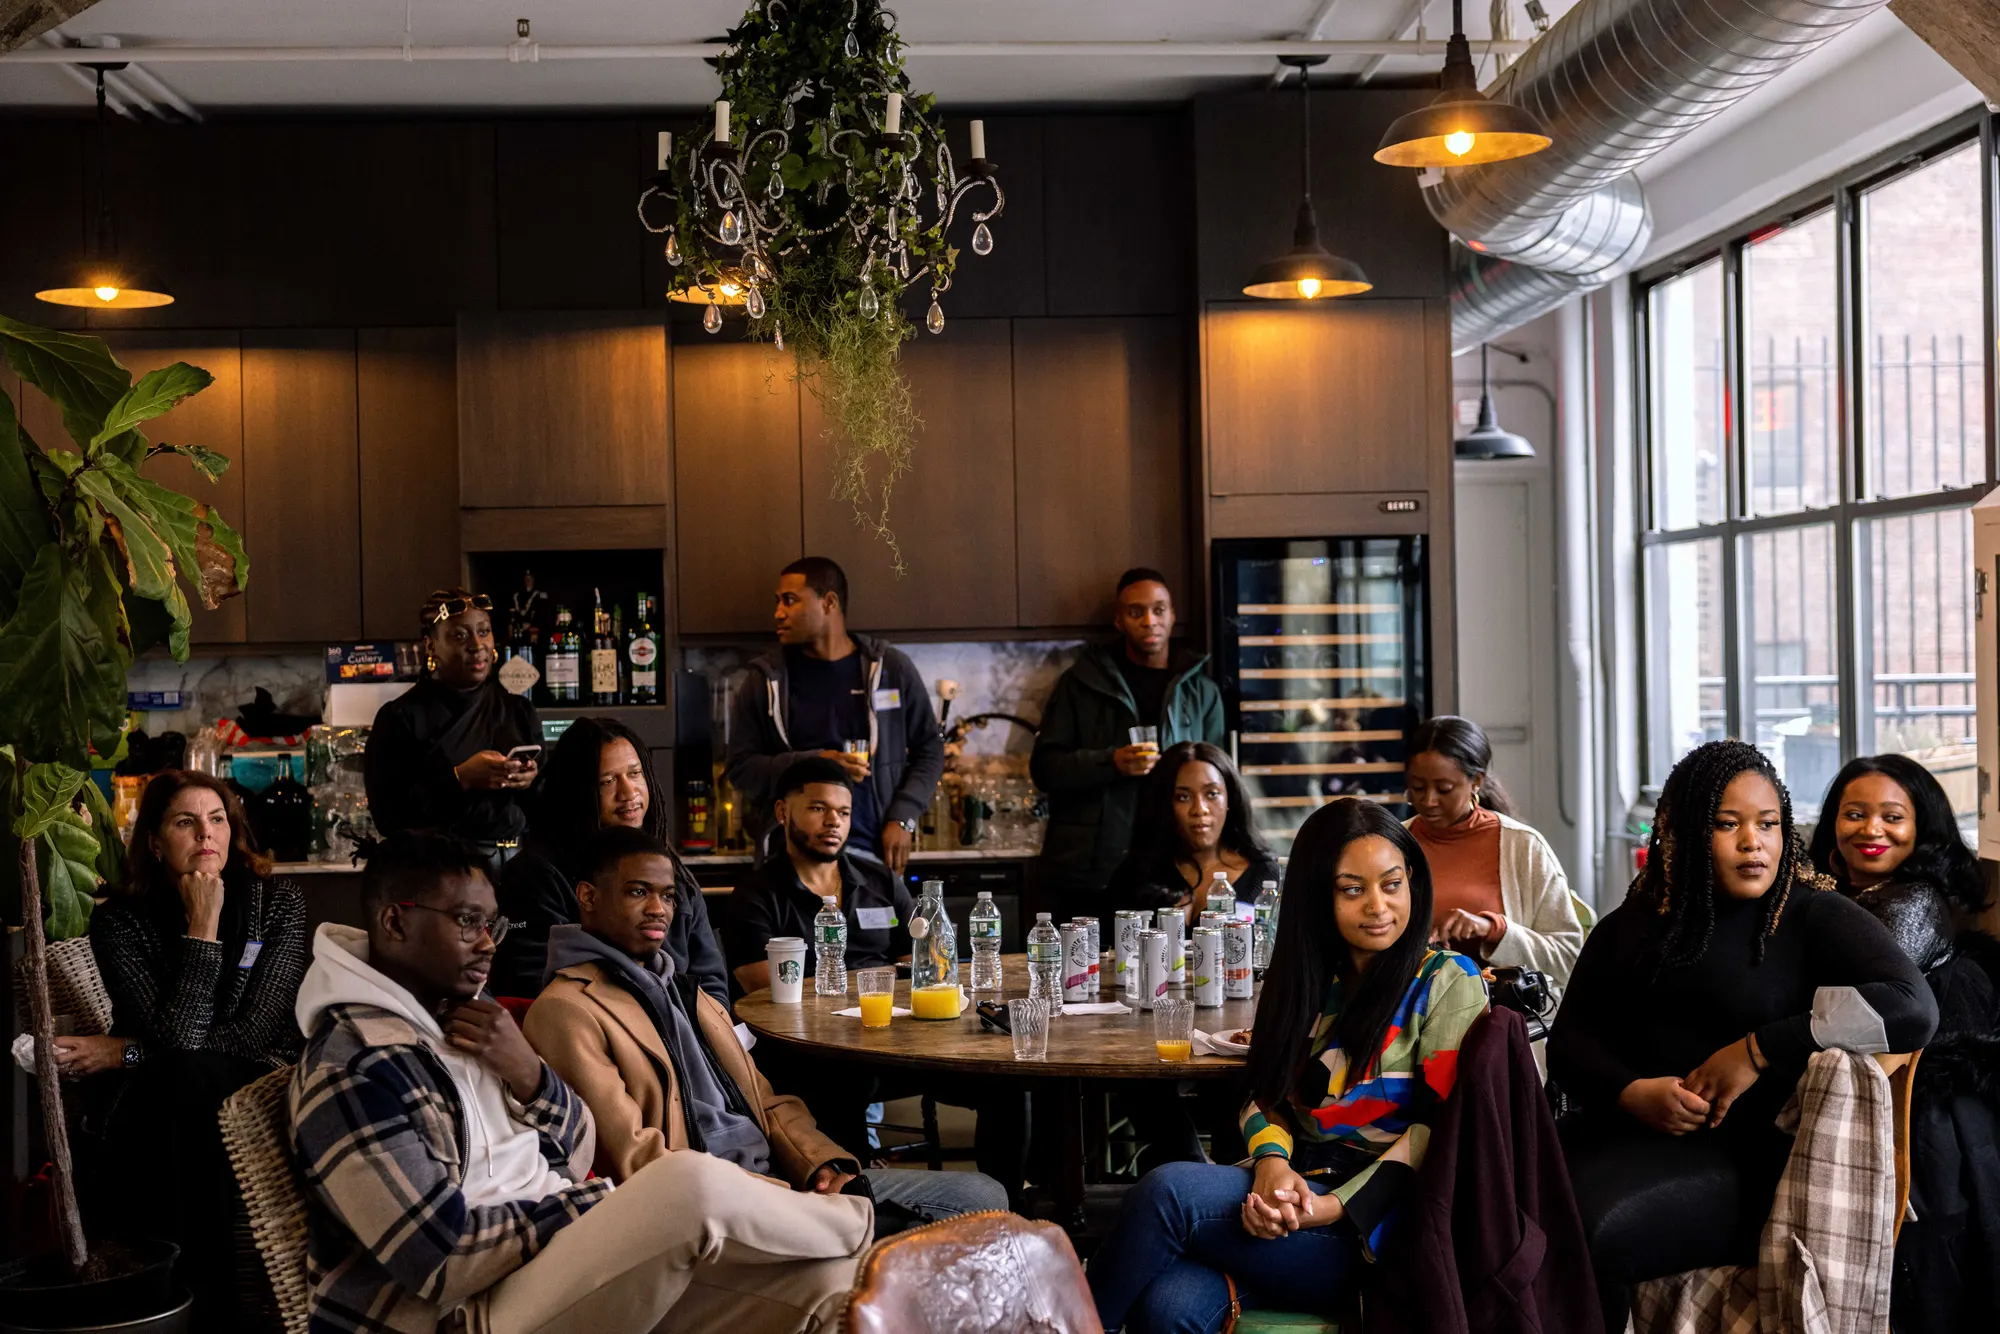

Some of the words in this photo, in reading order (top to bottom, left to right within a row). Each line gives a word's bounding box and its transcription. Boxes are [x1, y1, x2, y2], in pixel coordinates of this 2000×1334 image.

[328, 646, 342, 656] 360
[347, 655, 383, 664] Cutlery
[508, 920, 527, 930] treet
[1121, 925, 1131, 942] WHITE
[1227, 933, 1244, 944] CLAW
[1070, 938, 1081, 957] WHITE
